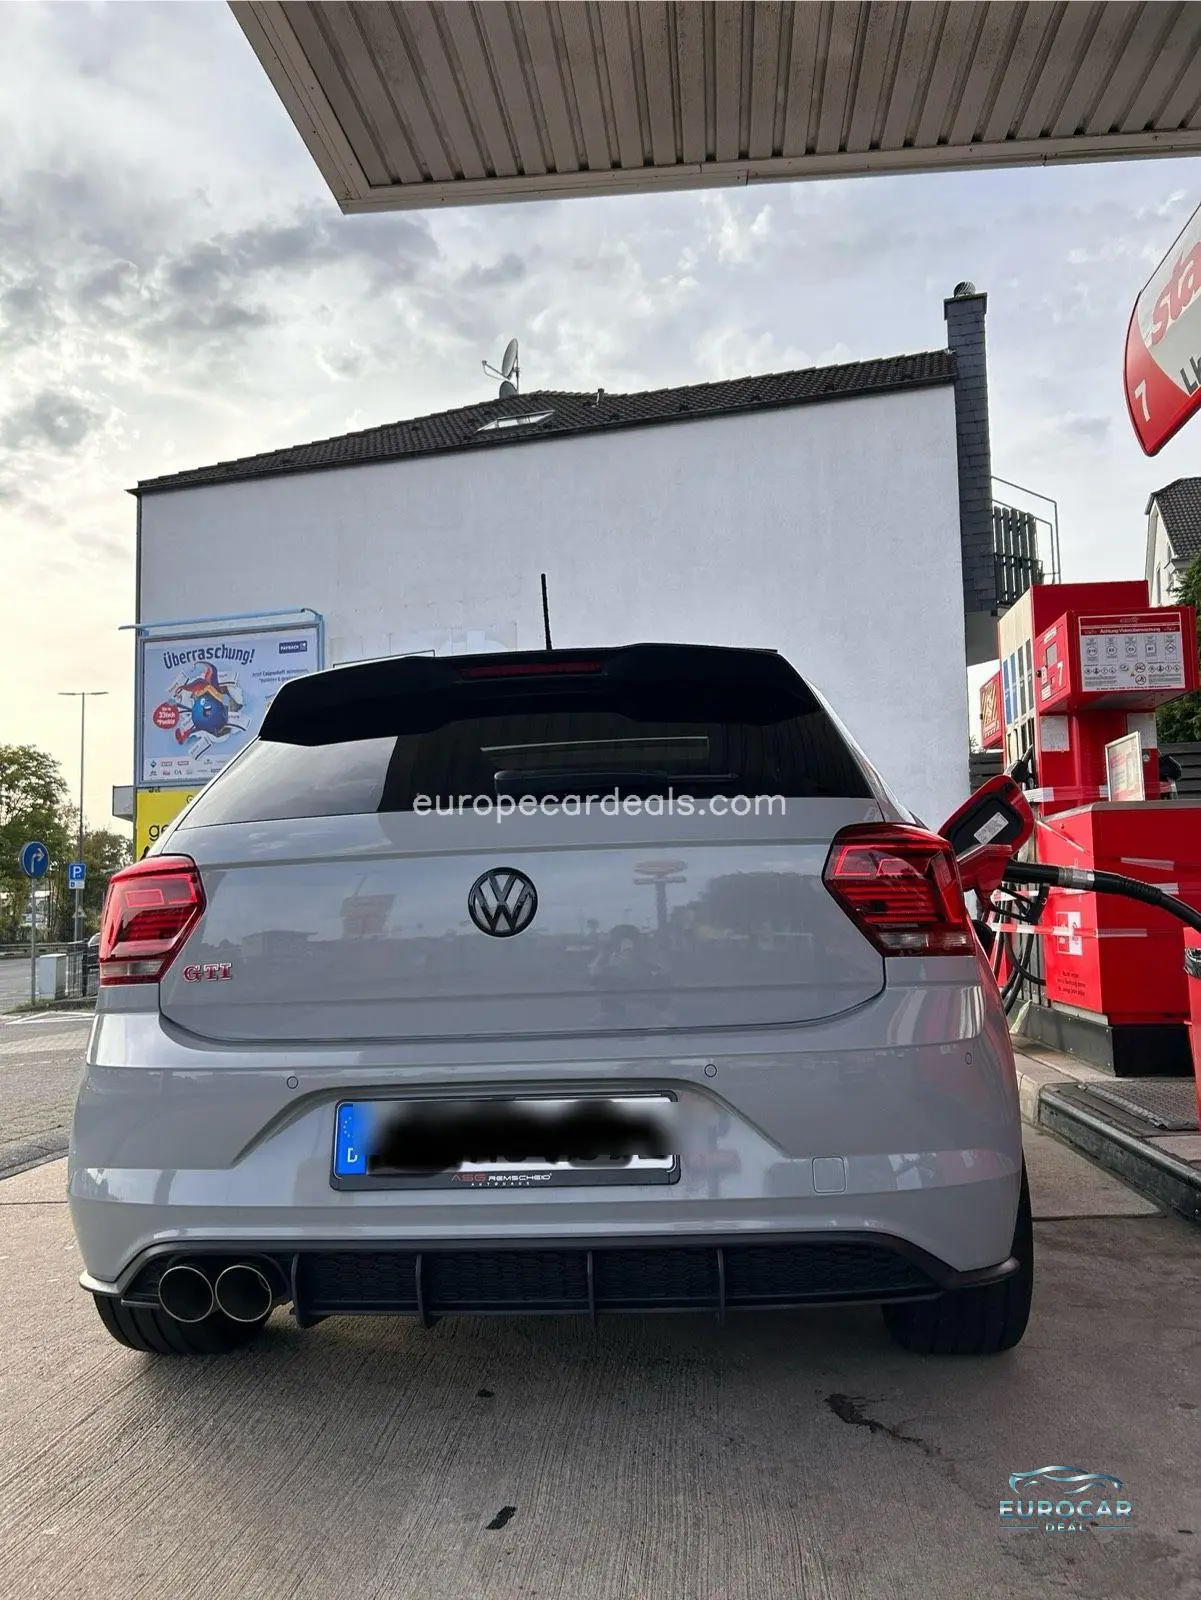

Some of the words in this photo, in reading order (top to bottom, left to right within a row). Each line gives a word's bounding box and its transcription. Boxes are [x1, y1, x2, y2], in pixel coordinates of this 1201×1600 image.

[1135, 380, 1150, 422] 7
[163, 644, 255, 669] Überraschung!
[73, 866, 82, 878] P
[183, 962, 233, 982] GTI
[450, 1173, 487, 1182] ASG
